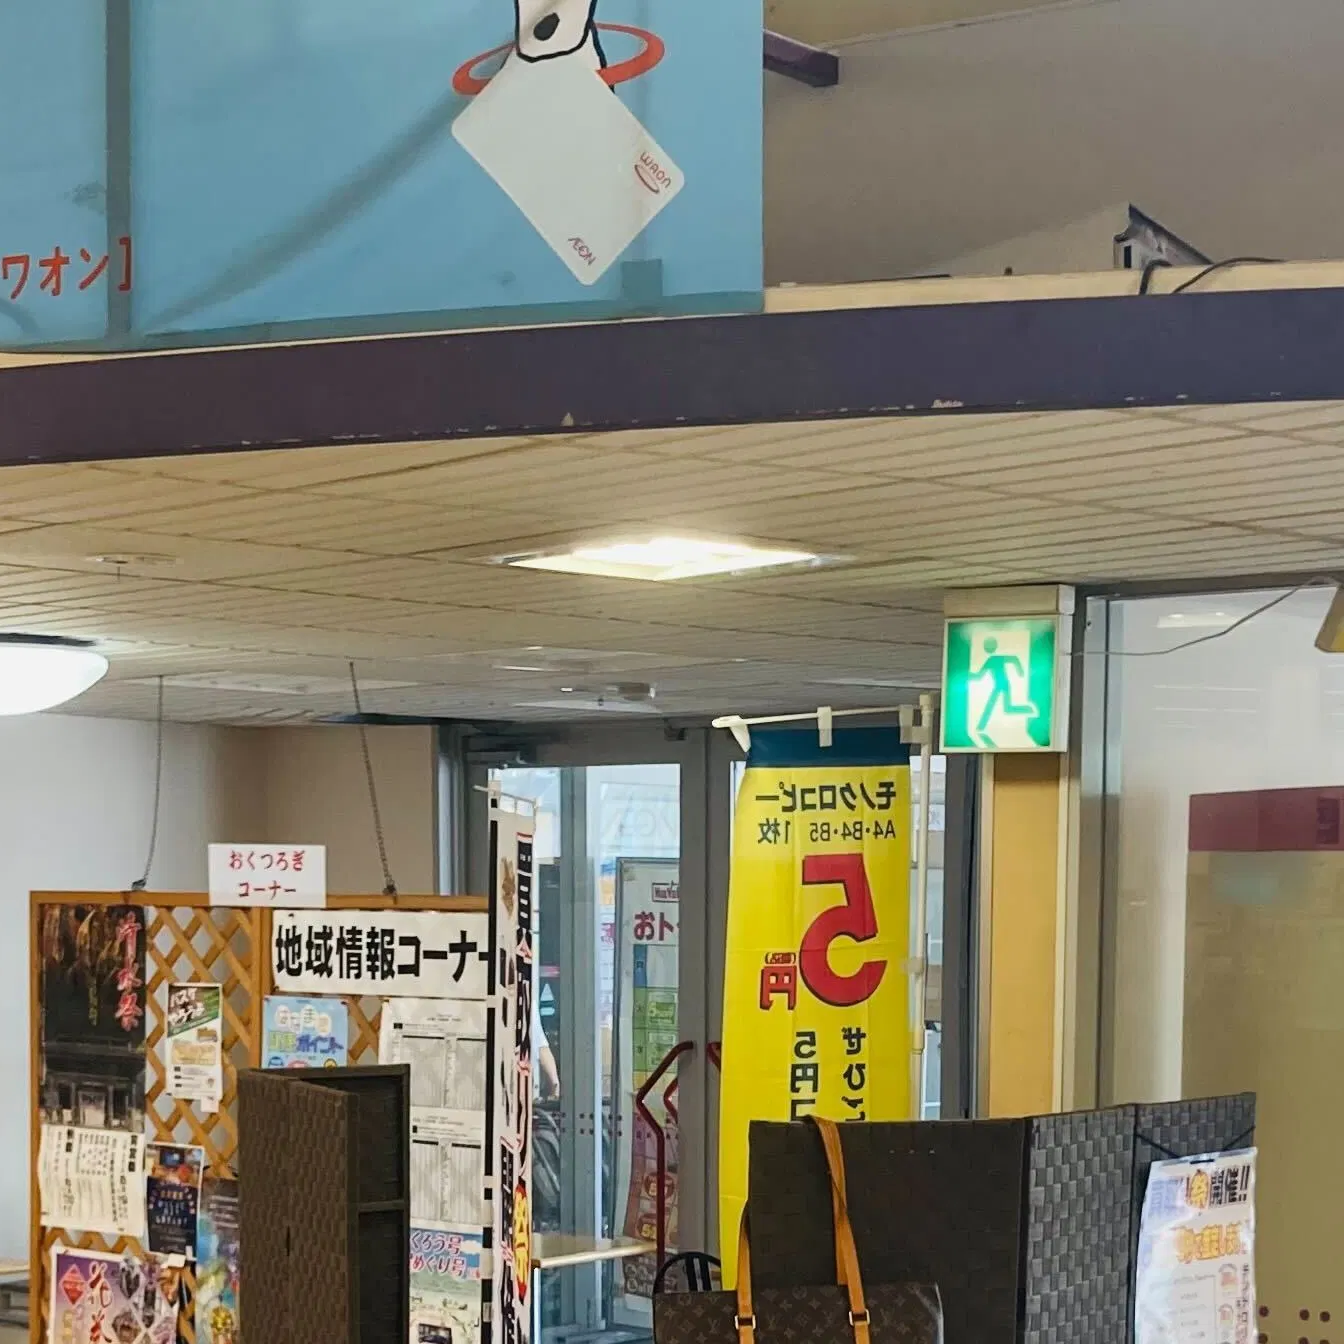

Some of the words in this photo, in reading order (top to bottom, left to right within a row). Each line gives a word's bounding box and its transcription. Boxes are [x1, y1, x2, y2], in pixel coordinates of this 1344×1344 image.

[639, 151, 672, 189] WAON
[228, 849, 306, 872] おくつろぎ
[238, 880, 298, 900] コーナー
[634, 910, 680, 942] おト
